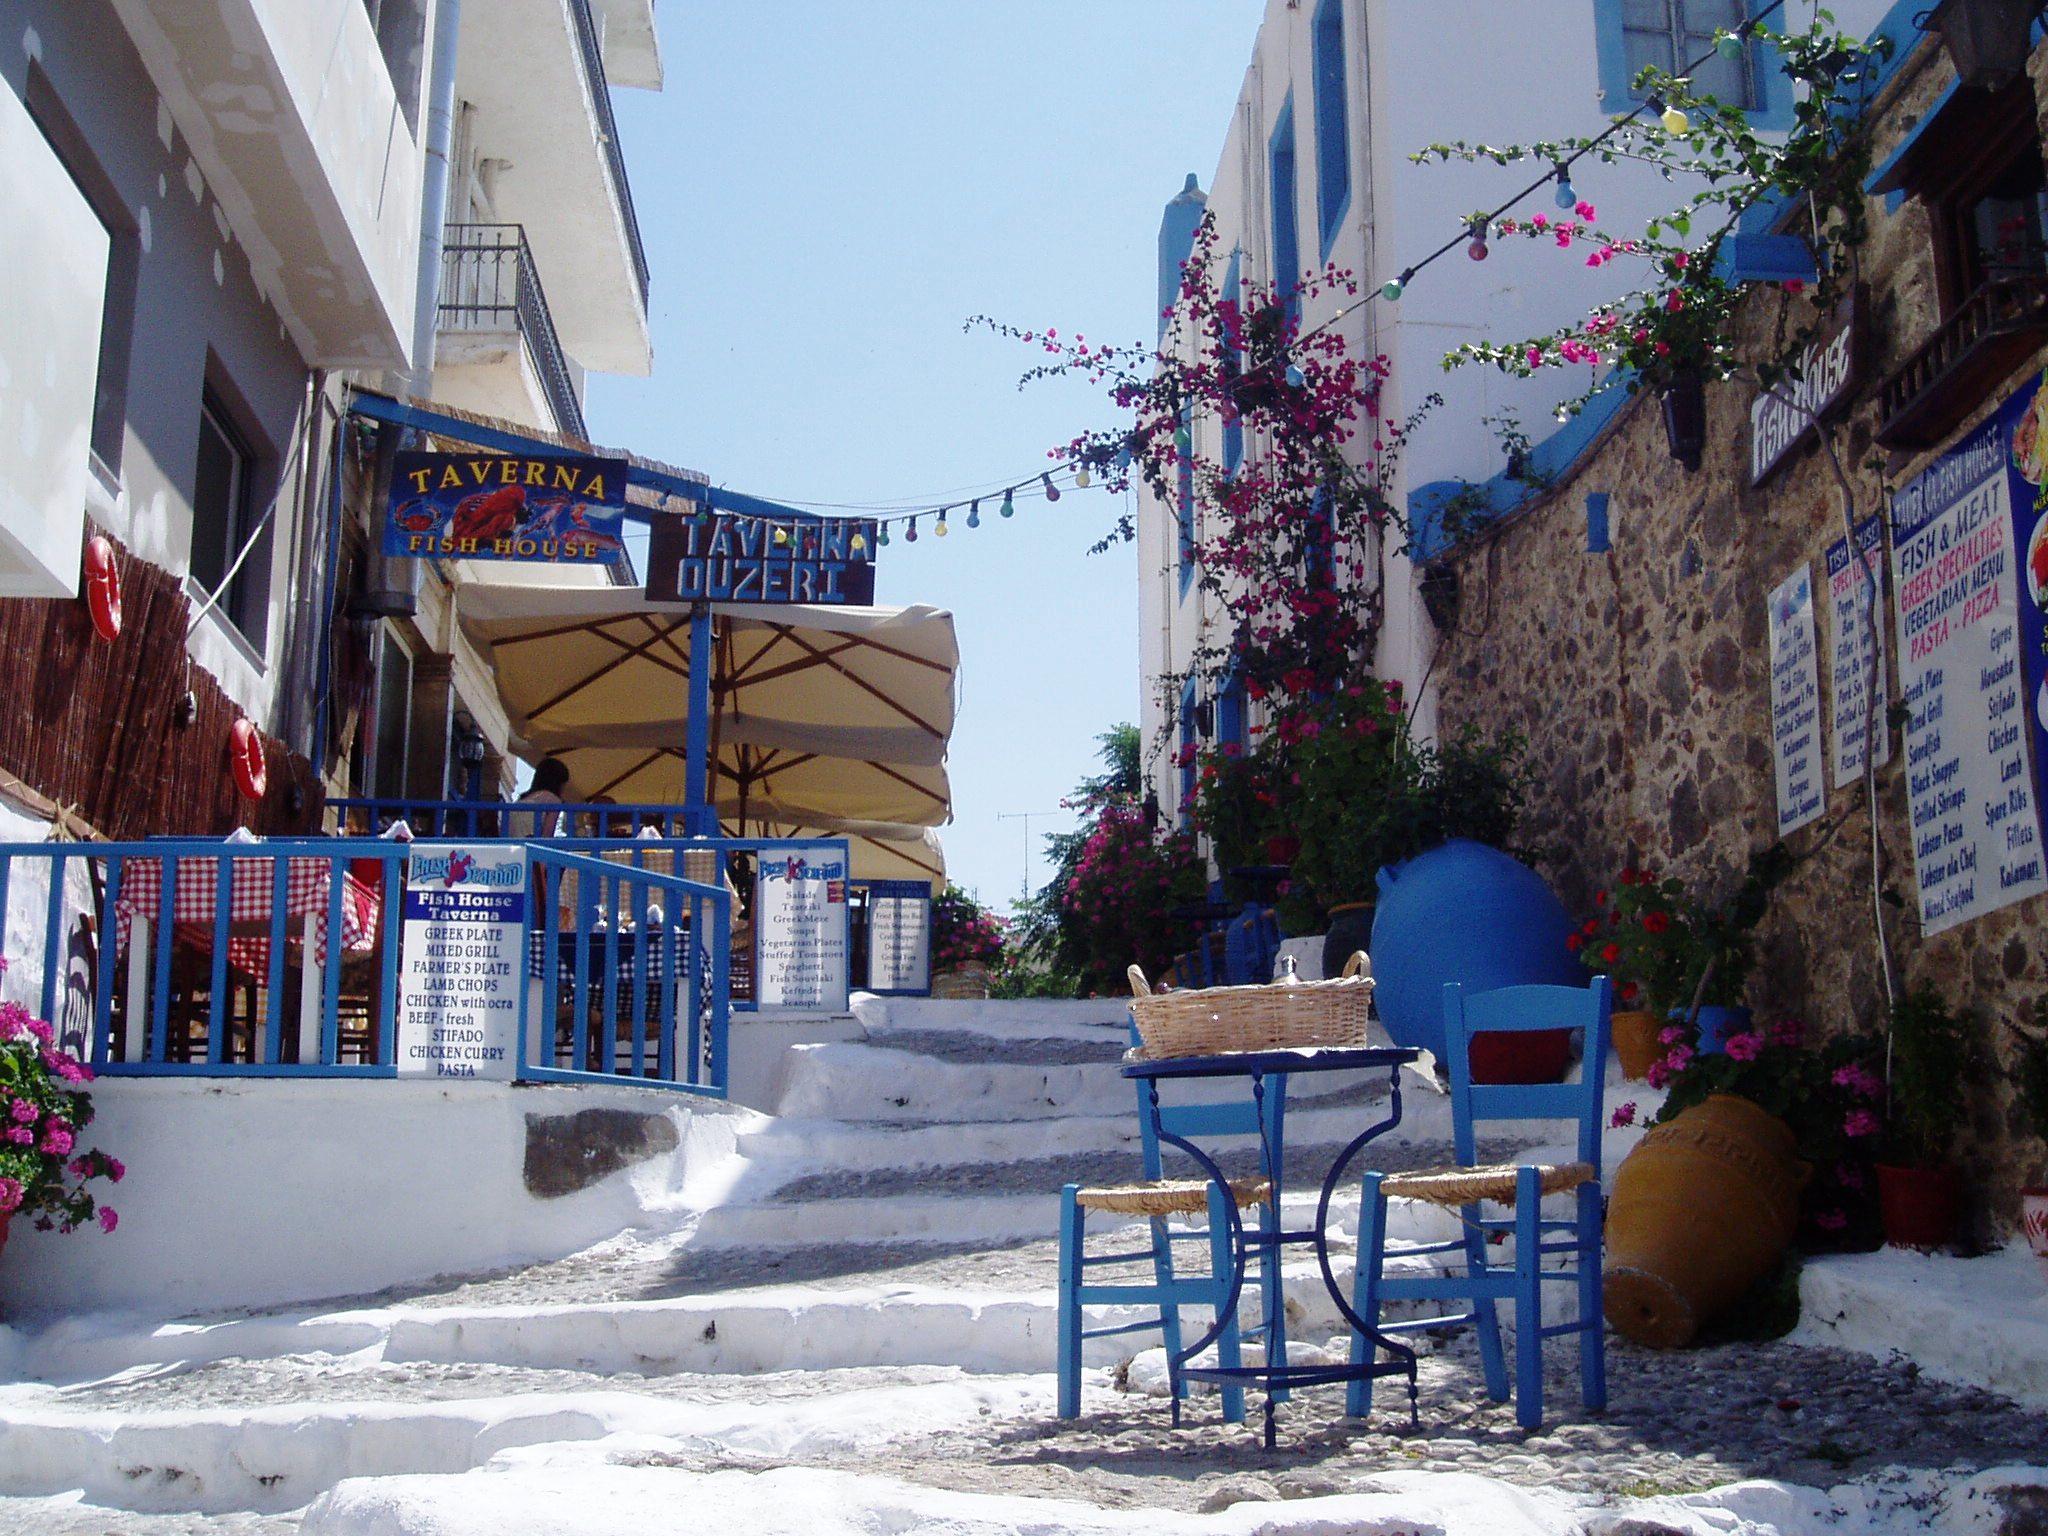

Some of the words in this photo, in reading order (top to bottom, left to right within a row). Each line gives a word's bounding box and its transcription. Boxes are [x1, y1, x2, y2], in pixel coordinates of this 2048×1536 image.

[409, 460, 605, 500] TAVERNA
[681, 515, 873, 560] TAVERNA
[1901, 526, 1935, 580] FISH
[1939, 522, 1949, 552] &
[1954, 480, 2001, 542] MEAT
[409, 536, 478, 554] FISH
[492, 537, 599, 558] HOUSE
[1829, 544, 1847, 574] FISH
[1901, 565, 1934, 613] GREEK
[1936, 515, 2004, 590] SPECIALTIES
[677, 558, 847, 601] OUZERI
[1904, 574, 1969, 638] VEGETARIAN
[1970, 550, 2004, 591] MENU
[1911, 615, 1949, 664] PASTA
[1962, 581, 2000, 629] PIZZA
[1990, 625, 2012, 655] Gyros
[1926, 668, 1943, 693] Plate
[1980, 653, 2014, 692] Mousaka
[1928, 694, 1943, 723] Grill
[1988, 686, 2016, 720] Stifado
[1909, 728, 1940, 767] Swordfish
[1988, 721, 2019, 754] Chicken
[1911, 766, 1930, 799] Black
[1932, 757, 1960, 788] Snapper
[2001, 750, 2022, 783] Lamb
[1913, 797, 1937, 828] Grilled
[1937, 787, 1966, 817] Shrimps
[1985, 800, 2008, 831] Spare
[2009, 784, 2028, 815] Ribs
[1917, 832, 1942, 859] Lobster
[1943, 823, 1963, 846] Pasta
[2007, 822, 2033, 851] Fillets
[1920, 862, 1945, 890] Lobster
[1960, 841, 1977, 873] Chef
[2000, 855, 2040, 889] Kalamari
[418, 892, 455, 905] Fish
[458, 893, 513, 907] House
[1946, 877, 1974, 913] Seafood
[428, 907, 500, 921] Taverna
[424, 927, 464, 941] GREEK
[466, 928, 503, 942] PLATE
[761, 938, 812, 949] Vegetarian
[814, 938, 843, 947] Plates
[425, 944, 463, 958] MIXED
[465, 945, 500, 958] GRILL
[760, 950, 795, 959] Stuffed
[798, 950, 844, 959] Tomatoes
[413, 960, 471, 975] FARMER'S
[474, 962, 511, 976] PLATE
[769, 974, 790, 983] Fish
[792, 974, 833, 983] Souvlaki
[779, 962, 824, 973] Spaghetti
[423, 977, 455, 991] LAMB
[457, 979, 498, 992] CHOPS
[406, 994, 459, 1008] CHICKEN
[461, 996, 486, 1009] with
[488, 999, 513, 1010] ocra
[408, 1012, 438, 1025] BEEF
[446, 1012, 474, 1026] fresh
[432, 1029, 484, 1042] STIFADO
[409, 1045, 461, 1059] CHICKEN
[464, 1047, 505, 1061] CURRY
[437, 1063, 475, 1077] PASTA
